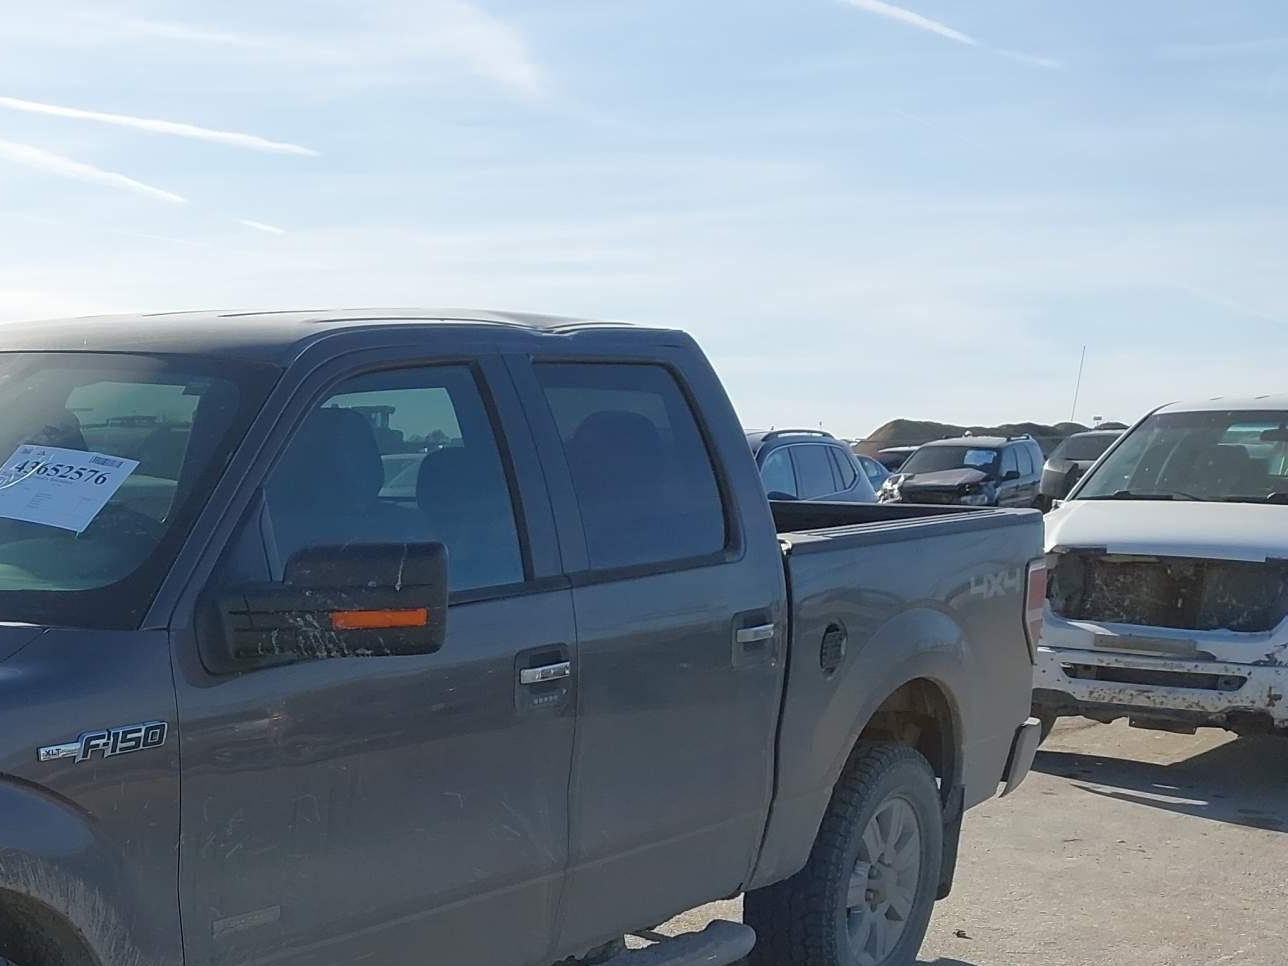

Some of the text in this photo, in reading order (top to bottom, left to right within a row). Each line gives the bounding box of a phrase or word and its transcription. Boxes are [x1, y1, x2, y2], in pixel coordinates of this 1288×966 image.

[14, 459, 111, 486] 43652576
[44, 721, 168, 763] XLT F-150
